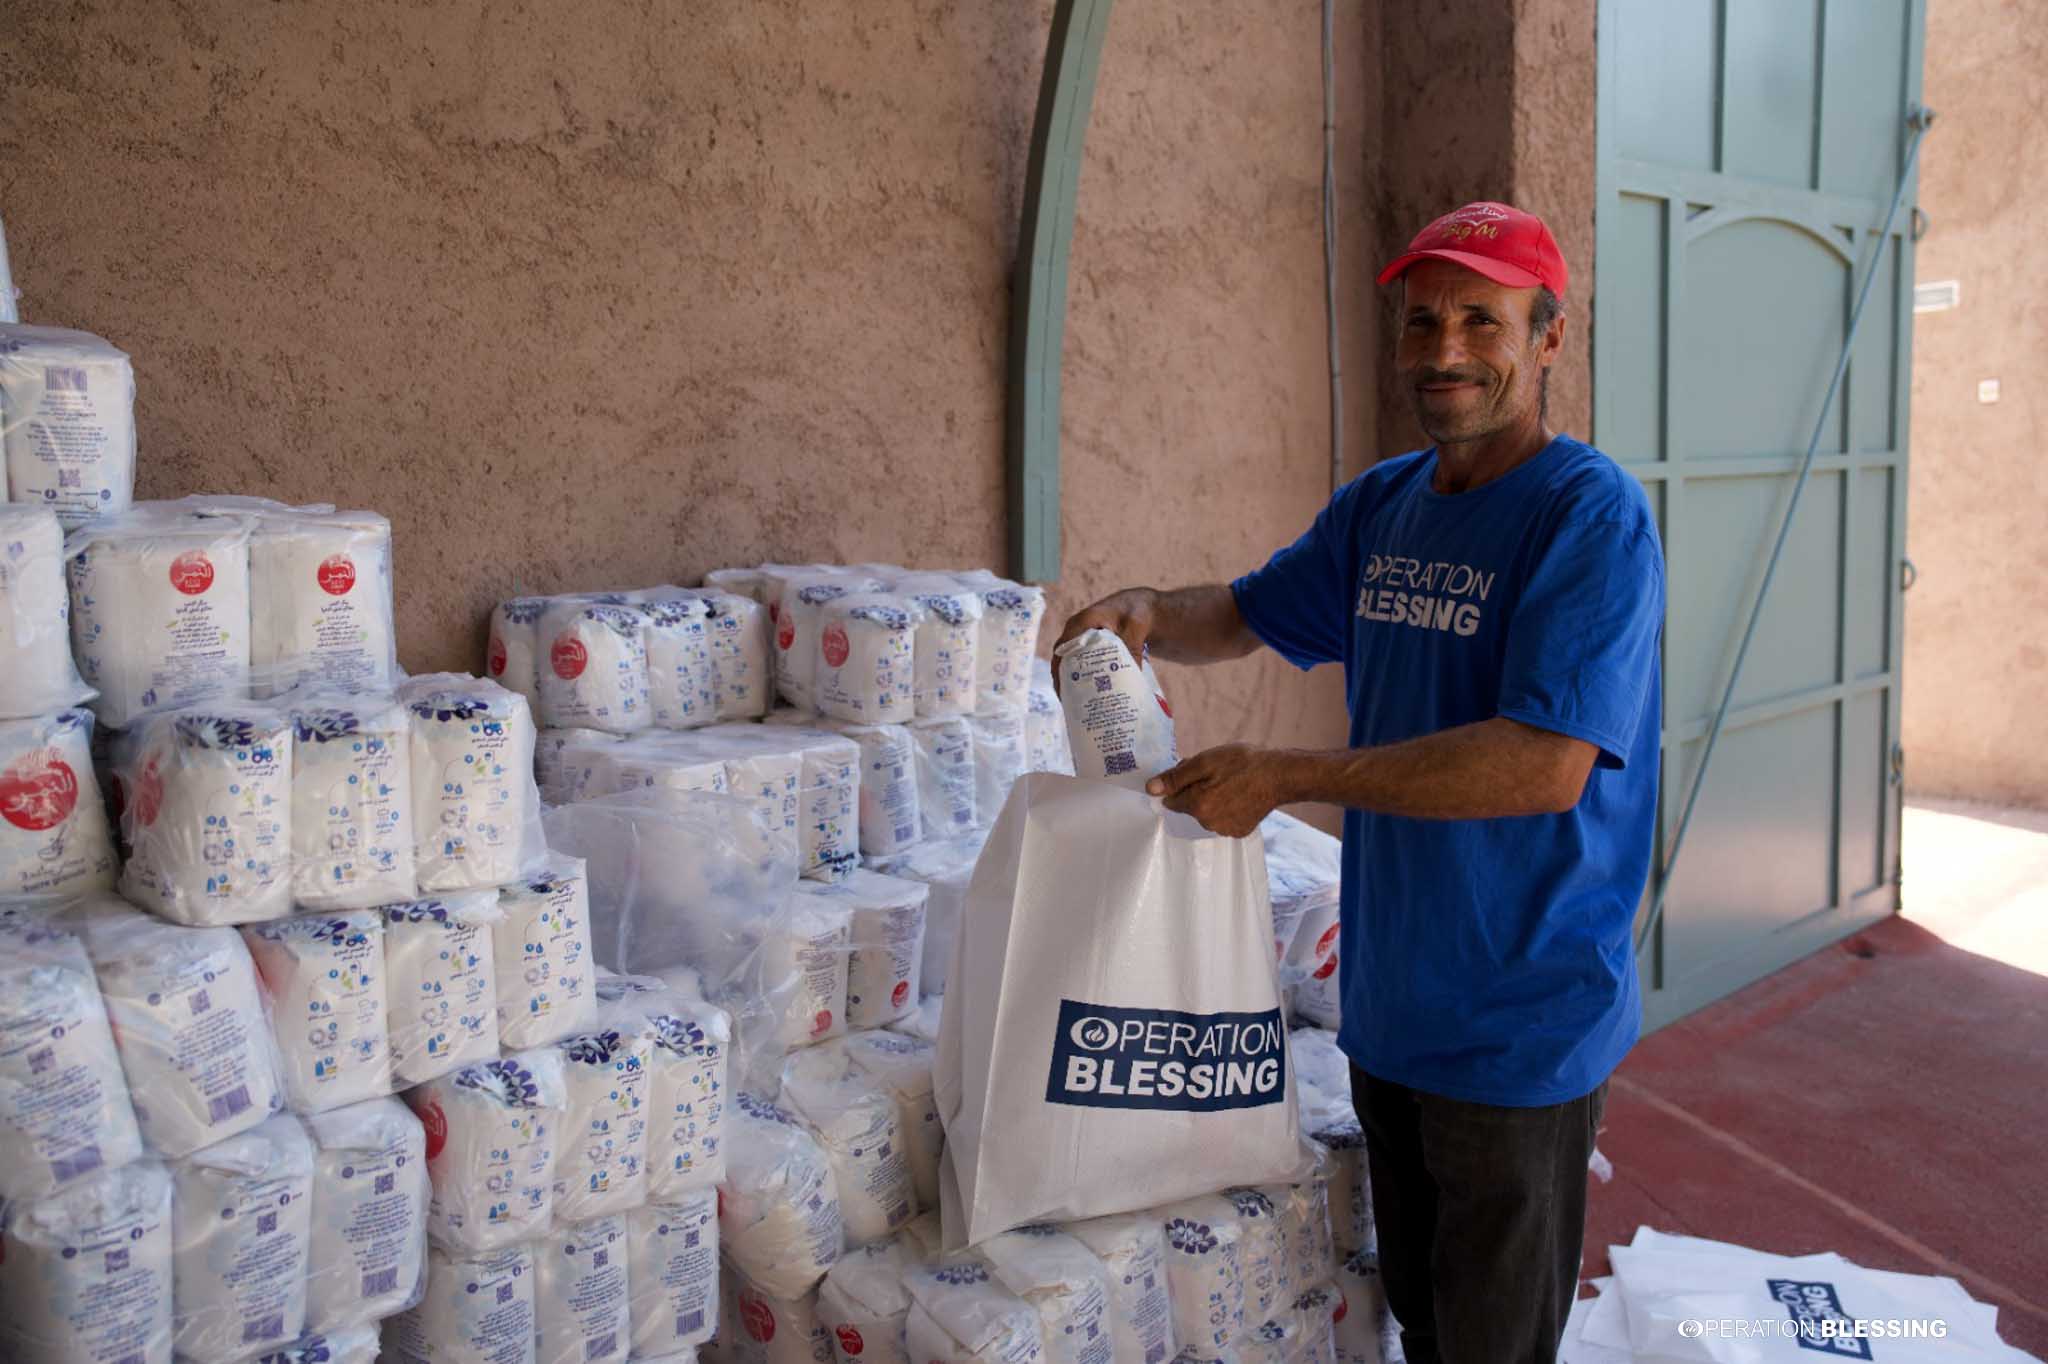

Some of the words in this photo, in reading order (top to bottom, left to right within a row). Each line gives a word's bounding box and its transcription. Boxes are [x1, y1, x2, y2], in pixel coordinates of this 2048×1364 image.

[1363, 553, 1496, 601] OPERATION
[1070, 1016, 1281, 1058] OPERATION
[1065, 1055, 1279, 1099] BLESSING
